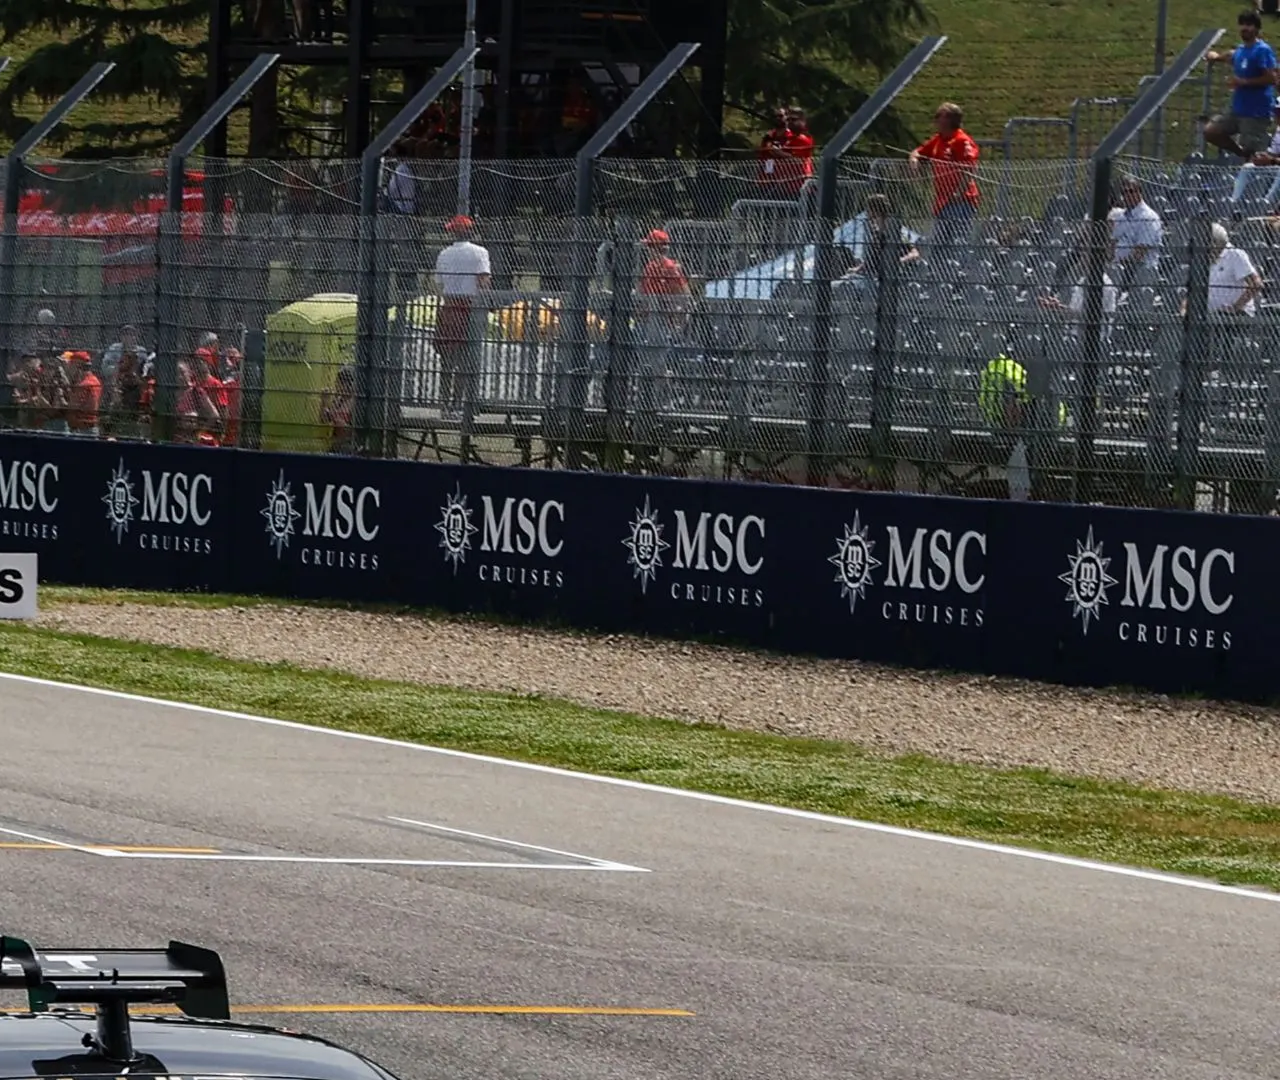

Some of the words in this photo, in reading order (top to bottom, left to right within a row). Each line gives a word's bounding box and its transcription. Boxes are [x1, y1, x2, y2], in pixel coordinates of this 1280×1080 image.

[141, 470, 212, 526] MSC
[302, 483, 380, 541] MSC
[140, 534, 211, 554] CRUISES
[481, 495, 564, 557] MSC
[673, 510, 765, 575] MSC
[301, 547, 378, 570] CRUISES
[479, 564, 563, 588] CRUISES
[884, 526, 986, 594] MSC
[1121, 542, 1234, 615] MSC
[672, 583, 763, 607] CRUISES
[883, 601, 984, 627] CRUISES
[1119, 622, 1232, 651] CRUISES
